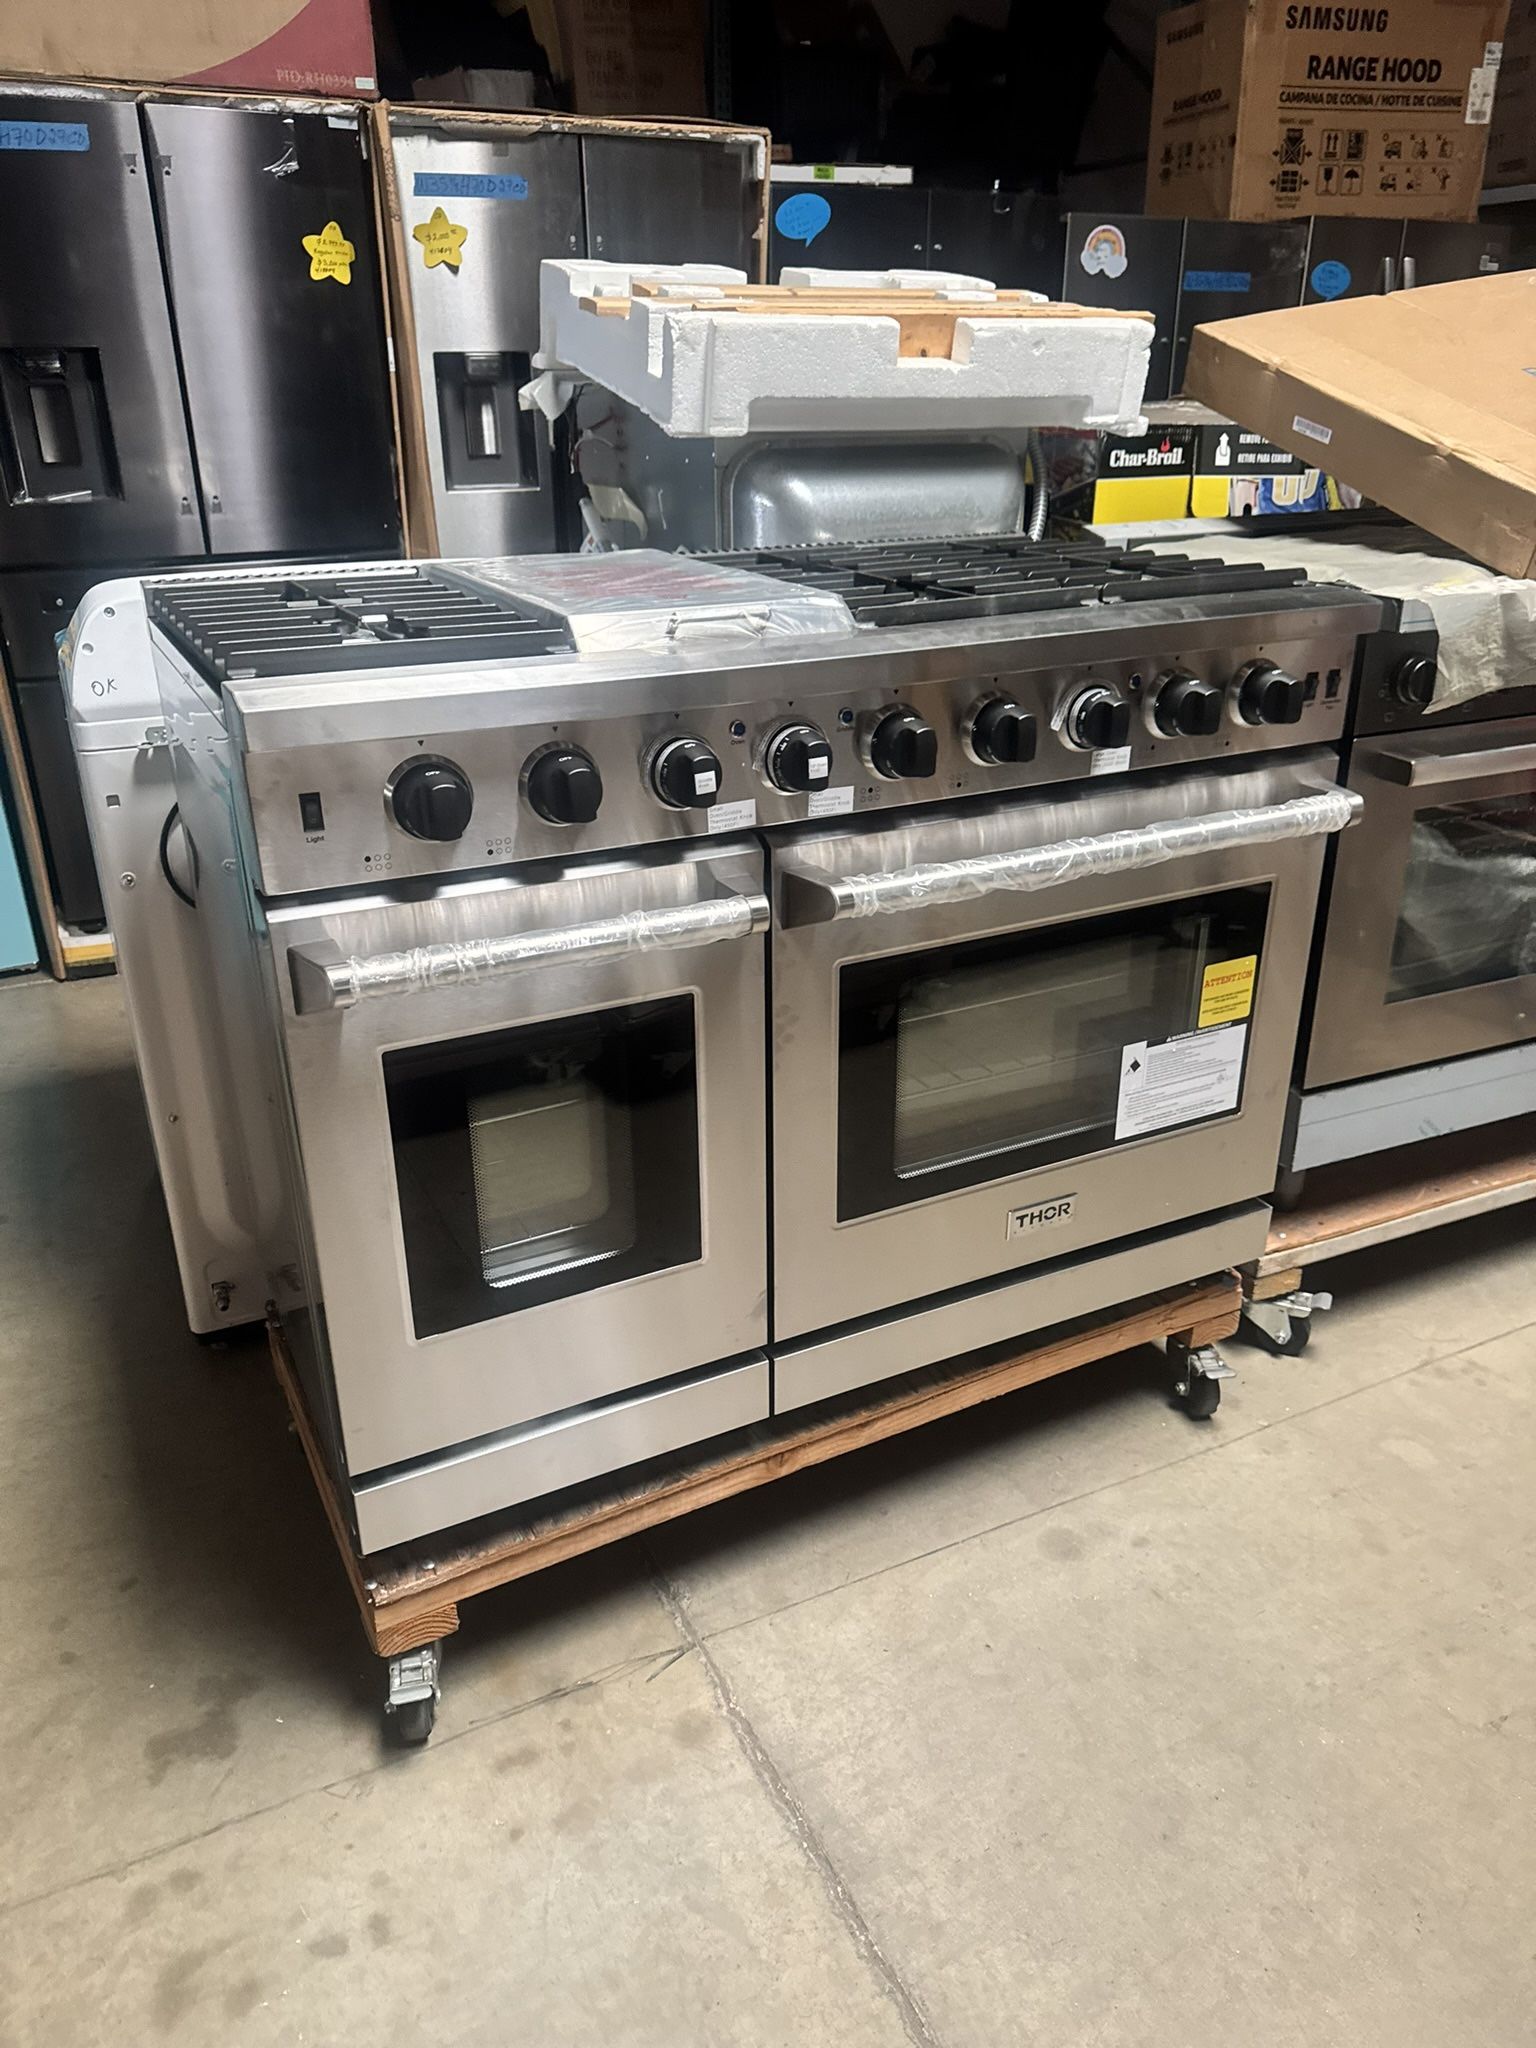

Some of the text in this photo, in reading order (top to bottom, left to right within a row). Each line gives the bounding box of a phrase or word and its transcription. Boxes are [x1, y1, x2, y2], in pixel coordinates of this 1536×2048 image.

[1286, 5, 1389, 32] SAMSUNG
[1307, 55, 1442, 83] RANGE HOOD
[1279, 91, 1324, 104] CAMPANA
[1326, 93, 1338, 104] DE
[1339, 94, 1374, 105] COCINA
[1380, 95, 1411, 107] HOTTE
[1412, 96, 1426, 107] DE
[1427, 96, 1463, 108] CUISINE
[91, 678, 118, 697] OK
[306, 835, 325, 844] Light
[1204, 970, 1253, 988] ATTENTION
[1016, 1202, 1071, 1228] THOR
